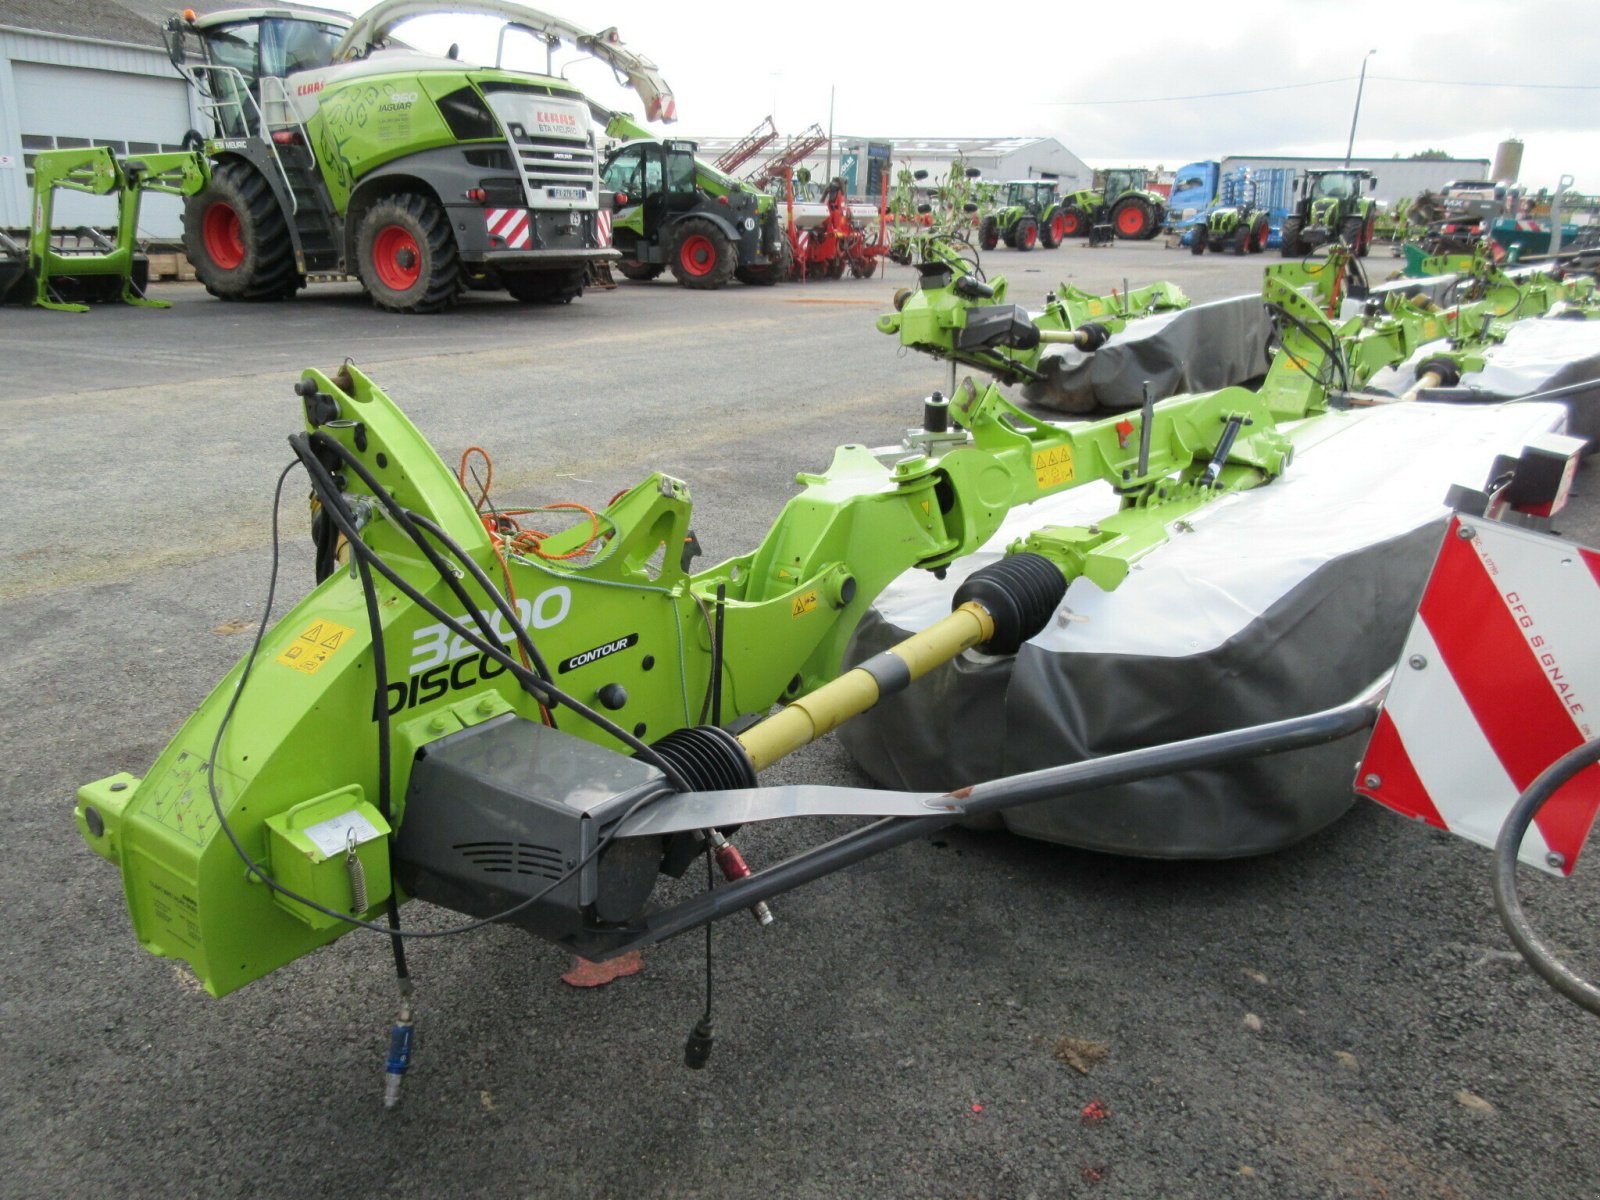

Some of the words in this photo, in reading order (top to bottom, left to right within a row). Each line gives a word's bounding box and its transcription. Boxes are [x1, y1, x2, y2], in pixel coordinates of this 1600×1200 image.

[297, 81, 324, 97] CLAAS
[378, 101, 412, 112] JAGUAR
[537, 112, 575, 126] CLAAS
[745, 219, 755, 230] 40
[409, 585, 572, 675] 3200
[569, 637, 628, 669] CONTOUR
[1505, 591, 1534, 629] CFG
[1530, 635, 1585, 716] SGNALE
[372, 645, 511, 722] DISCO
